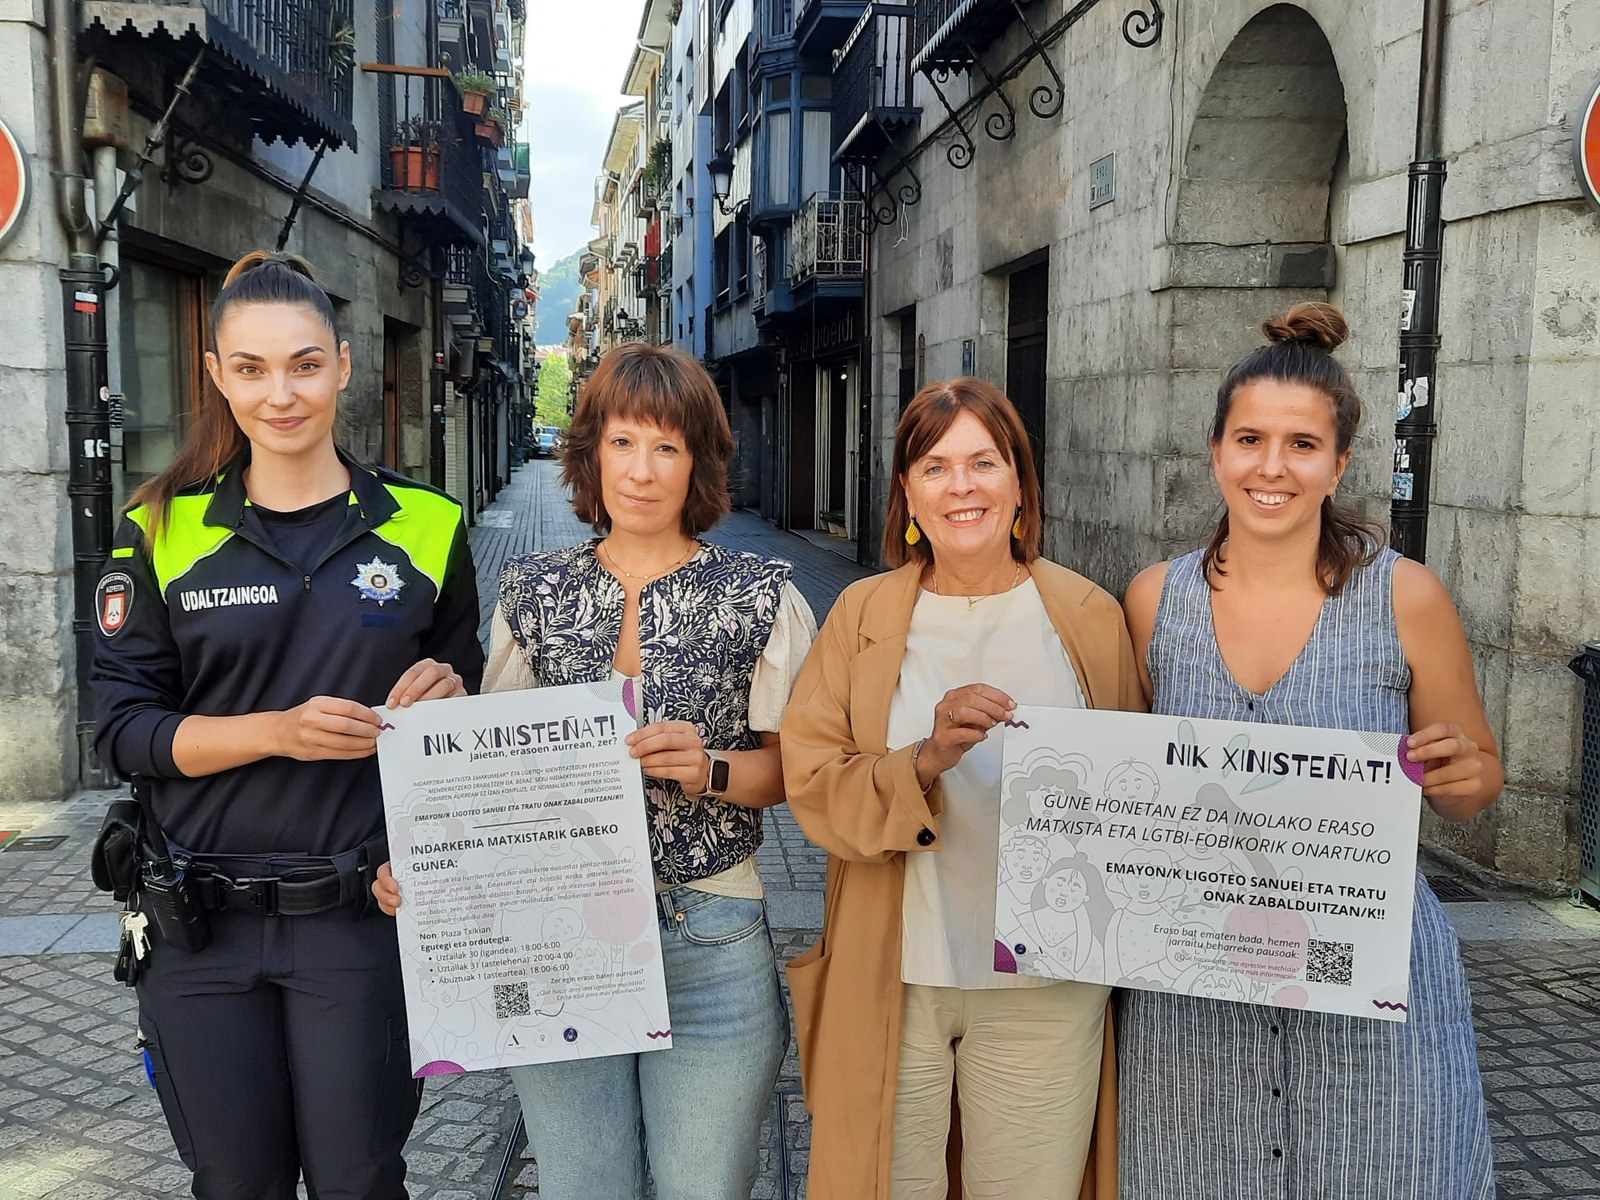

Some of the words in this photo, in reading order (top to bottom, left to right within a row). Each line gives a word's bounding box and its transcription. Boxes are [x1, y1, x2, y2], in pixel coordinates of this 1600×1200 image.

[180, 585, 278, 611] UDALTZAINGOA
[423, 731, 463, 756] NIK
[471, 715, 615, 750] XINISTEÑAT!
[469, 749, 507, 761] Jaietan,
[510, 745, 549, 756] erasoen
[552, 739, 594, 752] aurrean,
[597, 736, 617, 746] zer?
[1166, 742, 1210, 768] NIK
[1221, 745, 1391, 783] XINISTEÑAT!
[1044, 793, 1091, 811] GUNE
[1095, 797, 1176, 818] HONETAN
[1181, 805, 1201, 821] EZ
[1206, 808, 1228, 824] DA
[1234, 810, 1312, 831] INOLAKO
[1317, 818, 1374, 837] ERASO
[410, 838, 484, 855] INDARKERIA
[487, 828, 566, 847] MATXISTARIK
[569, 823, 618, 838] GABEKO
[1026, 816, 1102, 836] MATXISTA
[1108, 823, 1136, 839] ETA
[1141, 827, 1287, 854] LGTBI-FOBIKORIK
[1291, 841, 1390, 864] ONARTUKO
[412, 858, 458, 872] GUNEA:
[1106, 861, 1181, 879] EMAYON/K
[1185, 869, 1246, 886] LIGOTEO
[1250, 876, 1302, 891] SANUEI
[1307, 882, 1333, 895] ETA
[1338, 885, 1385, 900] TRATU
[1203, 890, 1245, 904] ONAK
[1248, 895, 1384, 919] ZABALDUITZAN/K!!
[463, 925, 491, 935] Txikian
[1153, 924, 1179, 935] Eraso
[1182, 927, 1196, 937] bat
[1200, 929, 1235, 941] ematen
[1238, 933, 1264, 945] bada,
[1267, 937, 1299, 948] hemen
[420, 942, 451, 953] Egutegi
[469, 934, 512, 947] ordutegia:
[436, 952, 466, 961] Uztailak
[521, 941, 560, 951] 18:00-6:00
[1168, 936, 1203, 950] jarraitu
[1206, 940, 1253, 953] beharreko
[1256, 946, 1299, 960] pausoak:
[437, 963, 467, 972] Uztailak
[470, 961, 478, 969] 31
[533, 951, 573, 962] 20:00-4:00
[438, 973, 474, 984] Abuztuak
[530, 963, 569, 974] 18:00-6:00
